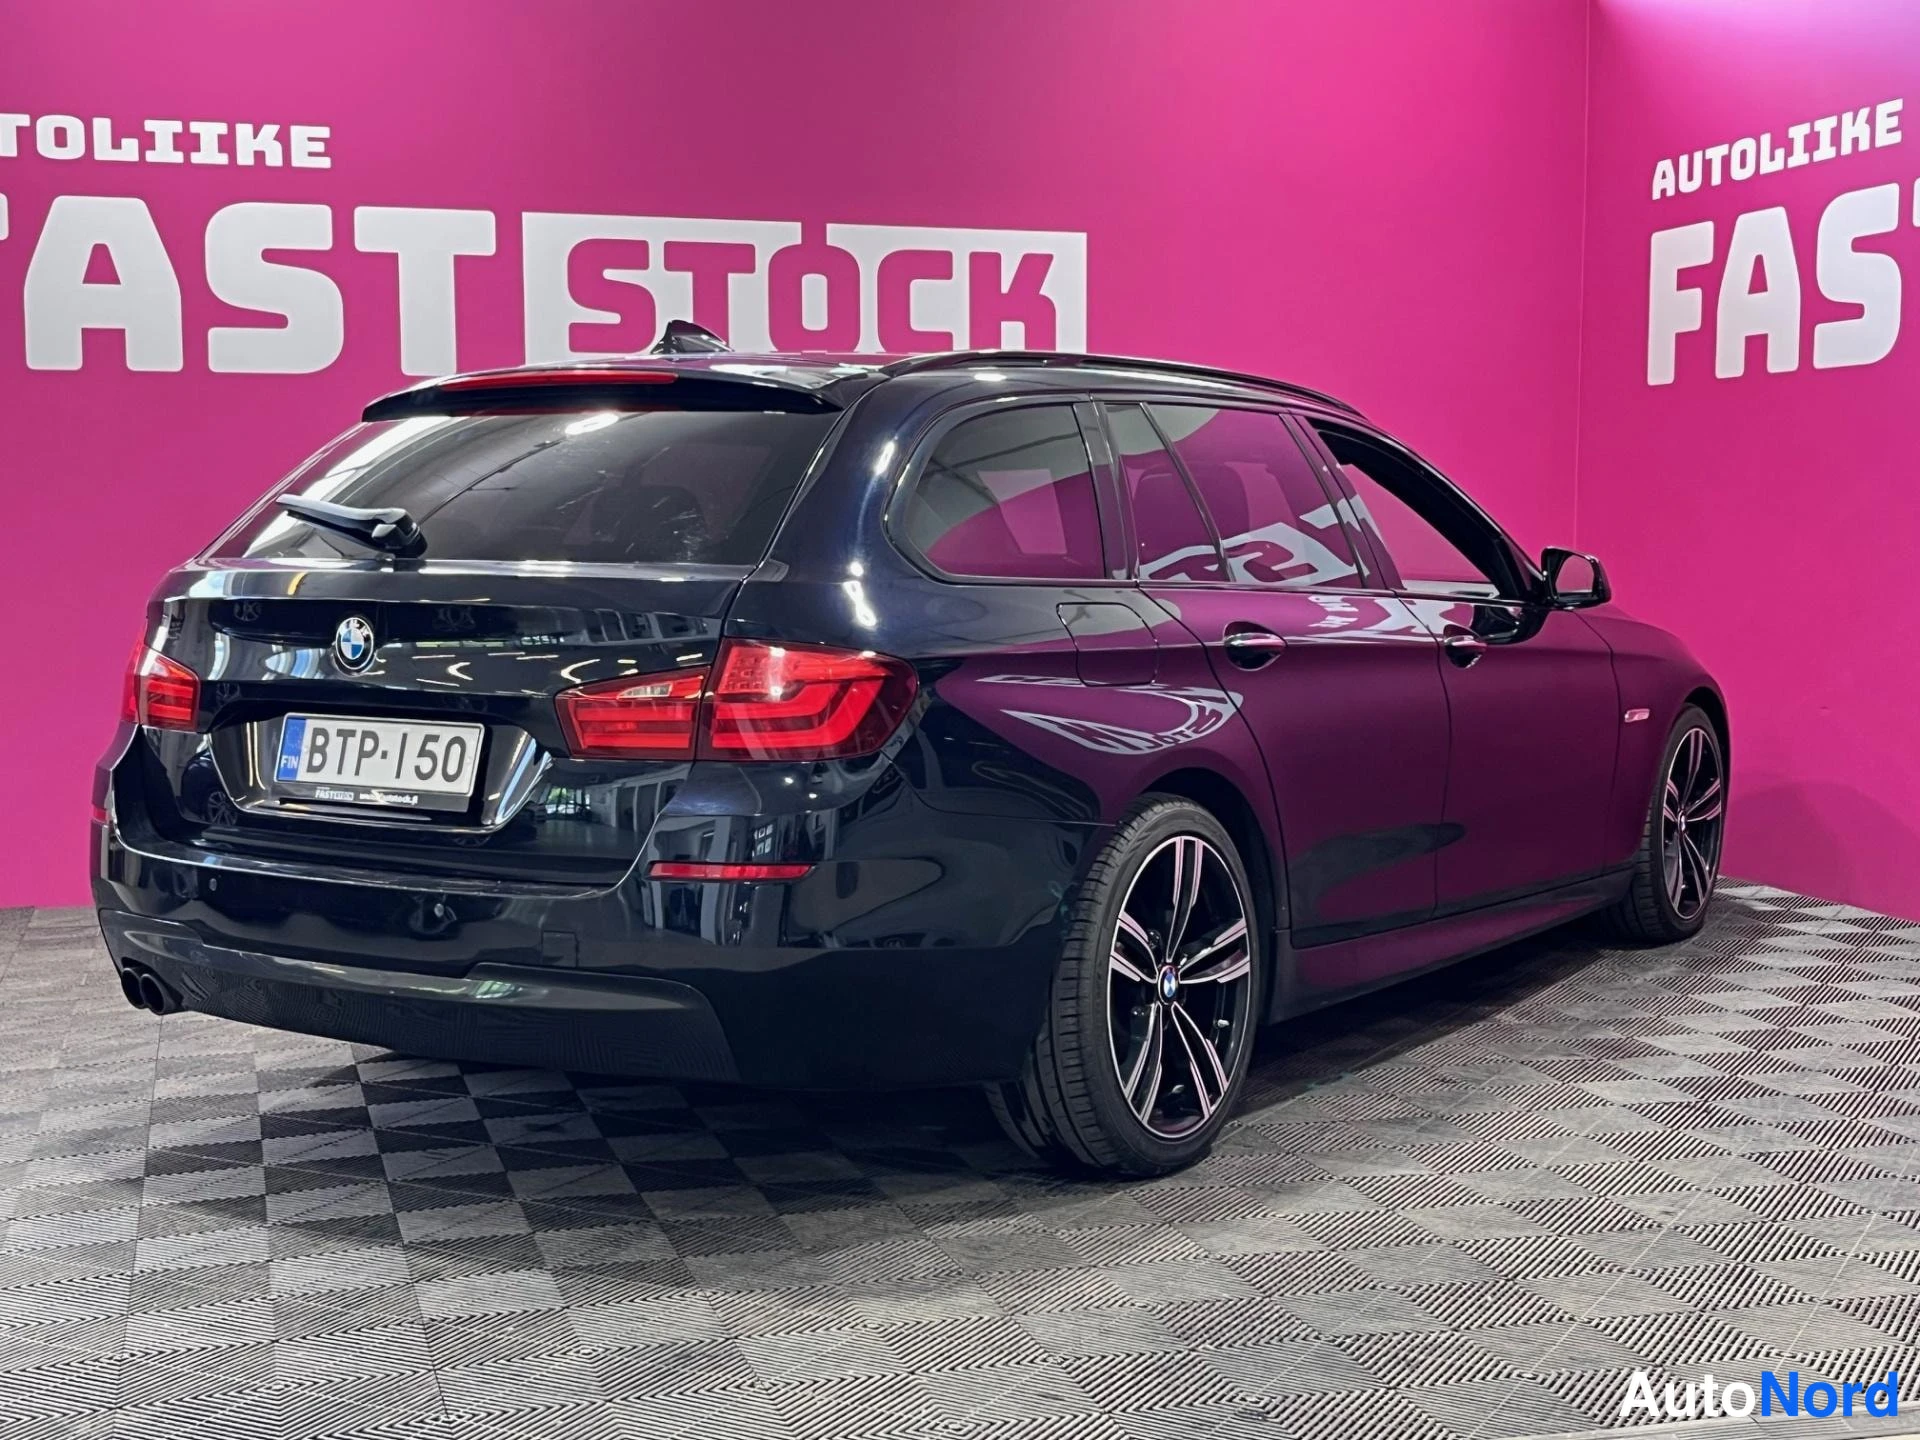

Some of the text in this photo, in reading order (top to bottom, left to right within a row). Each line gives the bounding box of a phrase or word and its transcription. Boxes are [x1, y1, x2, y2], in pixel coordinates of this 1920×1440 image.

[1652, 98, 1904, 201] AUTOLIIKE
[0, 192, 497, 377] AST
[1647, 177, 1920, 387] FAS
[280, 755, 299, 769] FIN
[305, 727, 467, 783] BTP-150
